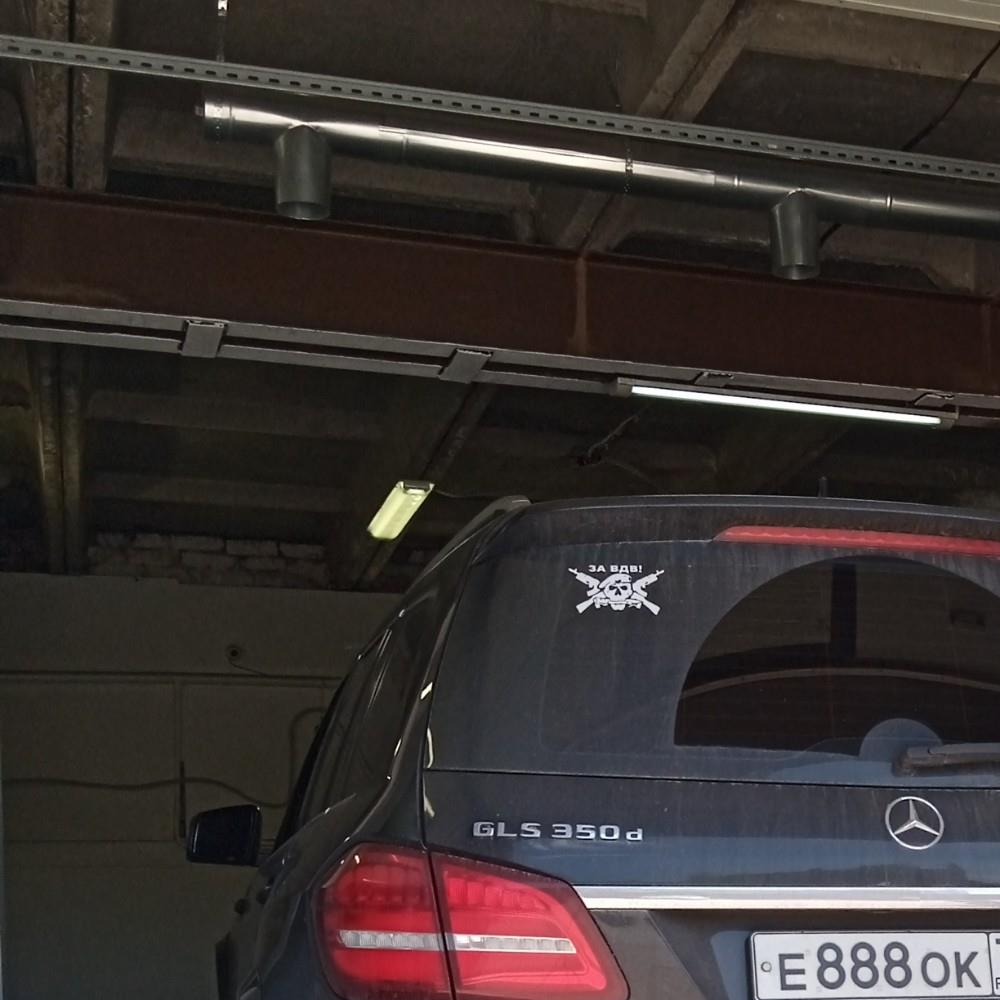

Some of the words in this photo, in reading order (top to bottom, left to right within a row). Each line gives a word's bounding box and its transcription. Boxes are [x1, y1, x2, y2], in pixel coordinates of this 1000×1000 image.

[588, 565, 606, 573] ЗА
[610, 565, 643, 574] ВДВ!
[472, 821, 542, 839] GLS
[551, 823, 644, 842] 350d
